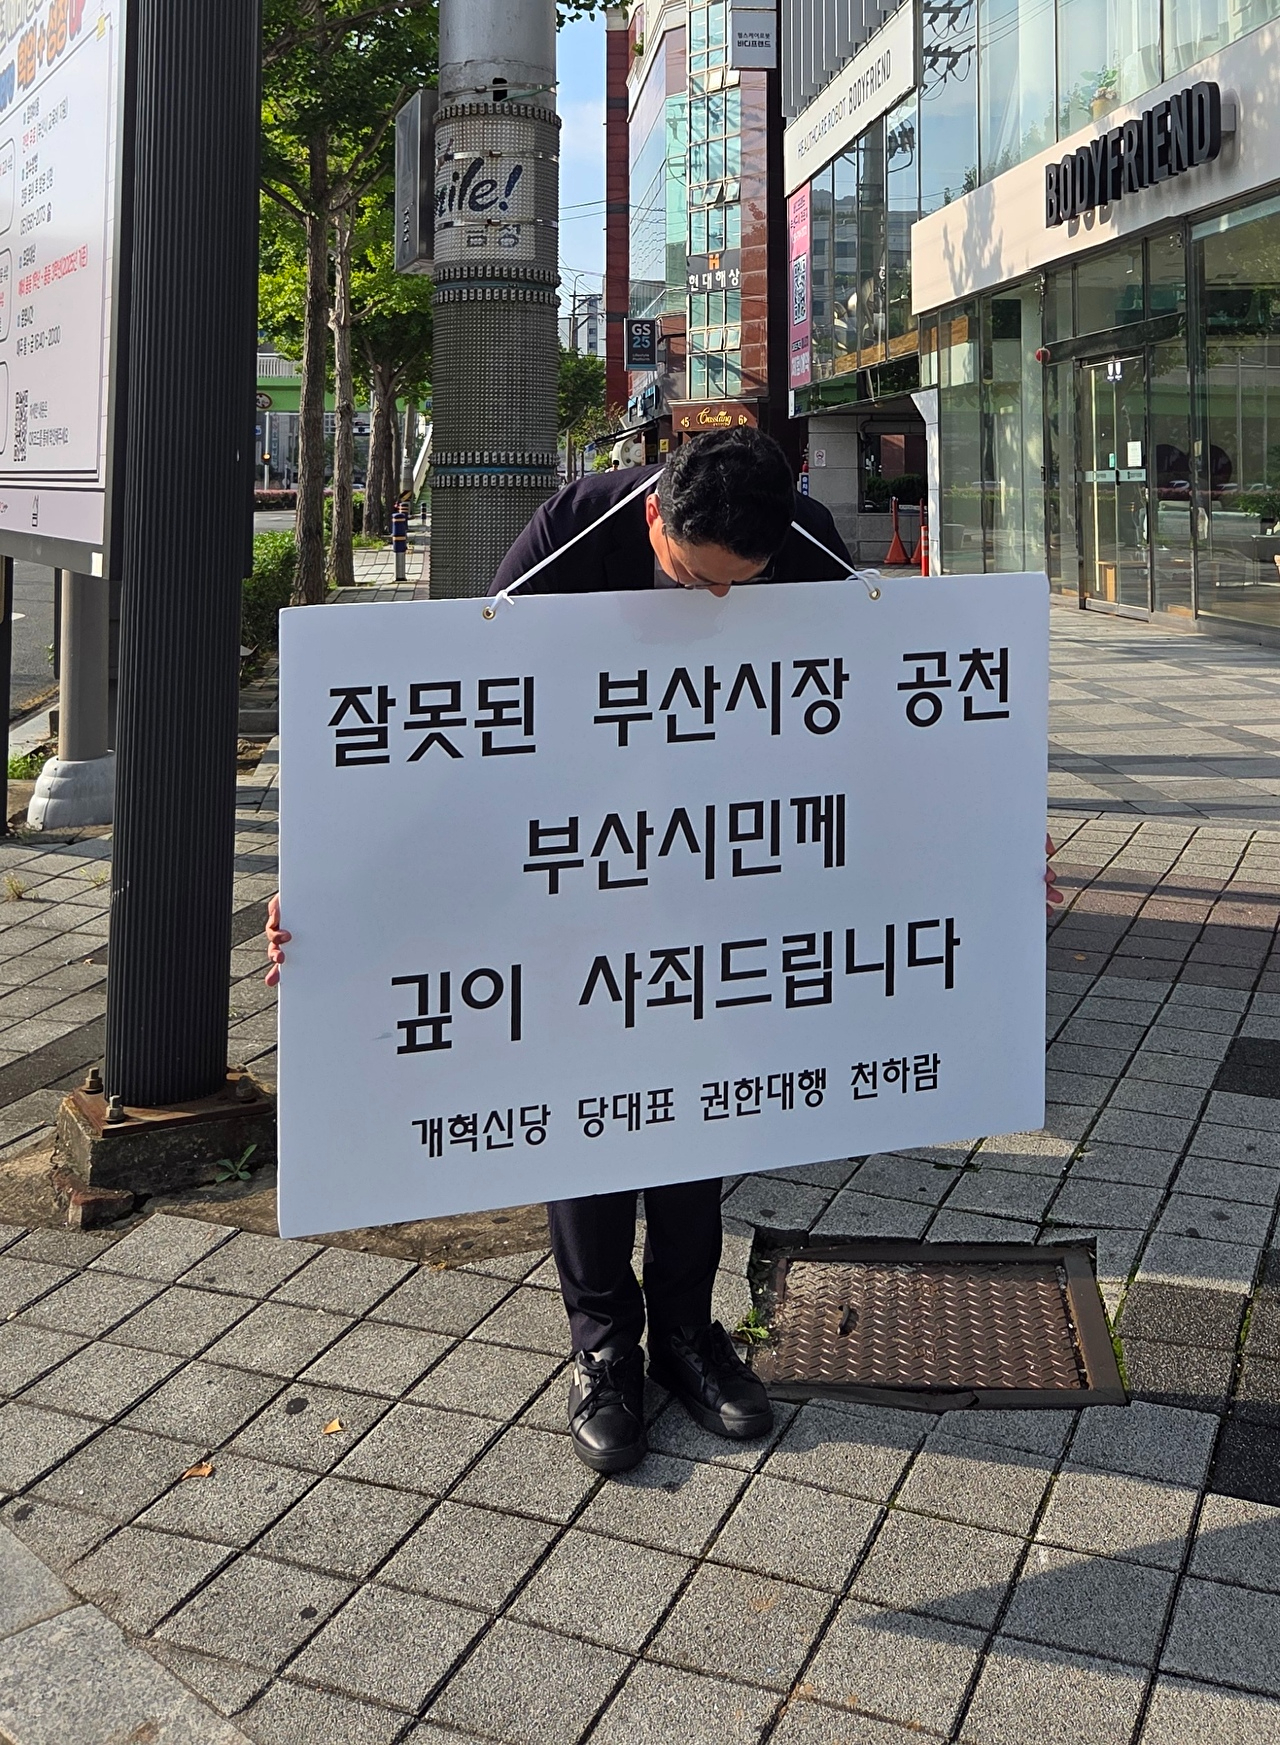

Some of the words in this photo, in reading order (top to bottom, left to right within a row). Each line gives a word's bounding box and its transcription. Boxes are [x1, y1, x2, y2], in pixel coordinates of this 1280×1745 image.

[17, 18, 38, 92] 학업
[797, 114, 828, 160] HEALTHCARE
[827, 97, 847, 132] ROBOT
[849, 49, 892, 116] BODYFRIEND
[1045, 81, 1221, 229] BODYFRIEND
[631, 323, 651, 336] GS
[688, 268, 741, 291] 현대해상
[632, 336, 651, 349] 25
[327, 676, 537, 768] 잘못된
[593, 656, 850, 748] 부산시장
[897, 647, 1010, 728] 공천
[523, 794, 846, 895] 부산시민께
[391, 963, 522, 1055] 깊이
[578, 917, 961, 1028] 사죄드립니다
[411, 1103, 552, 1158] 개혁신당
[578, 1087, 676, 1138] 당대표
[700, 1067, 827, 1121] 권한대행
[850, 1052, 941, 1101] 천하람
